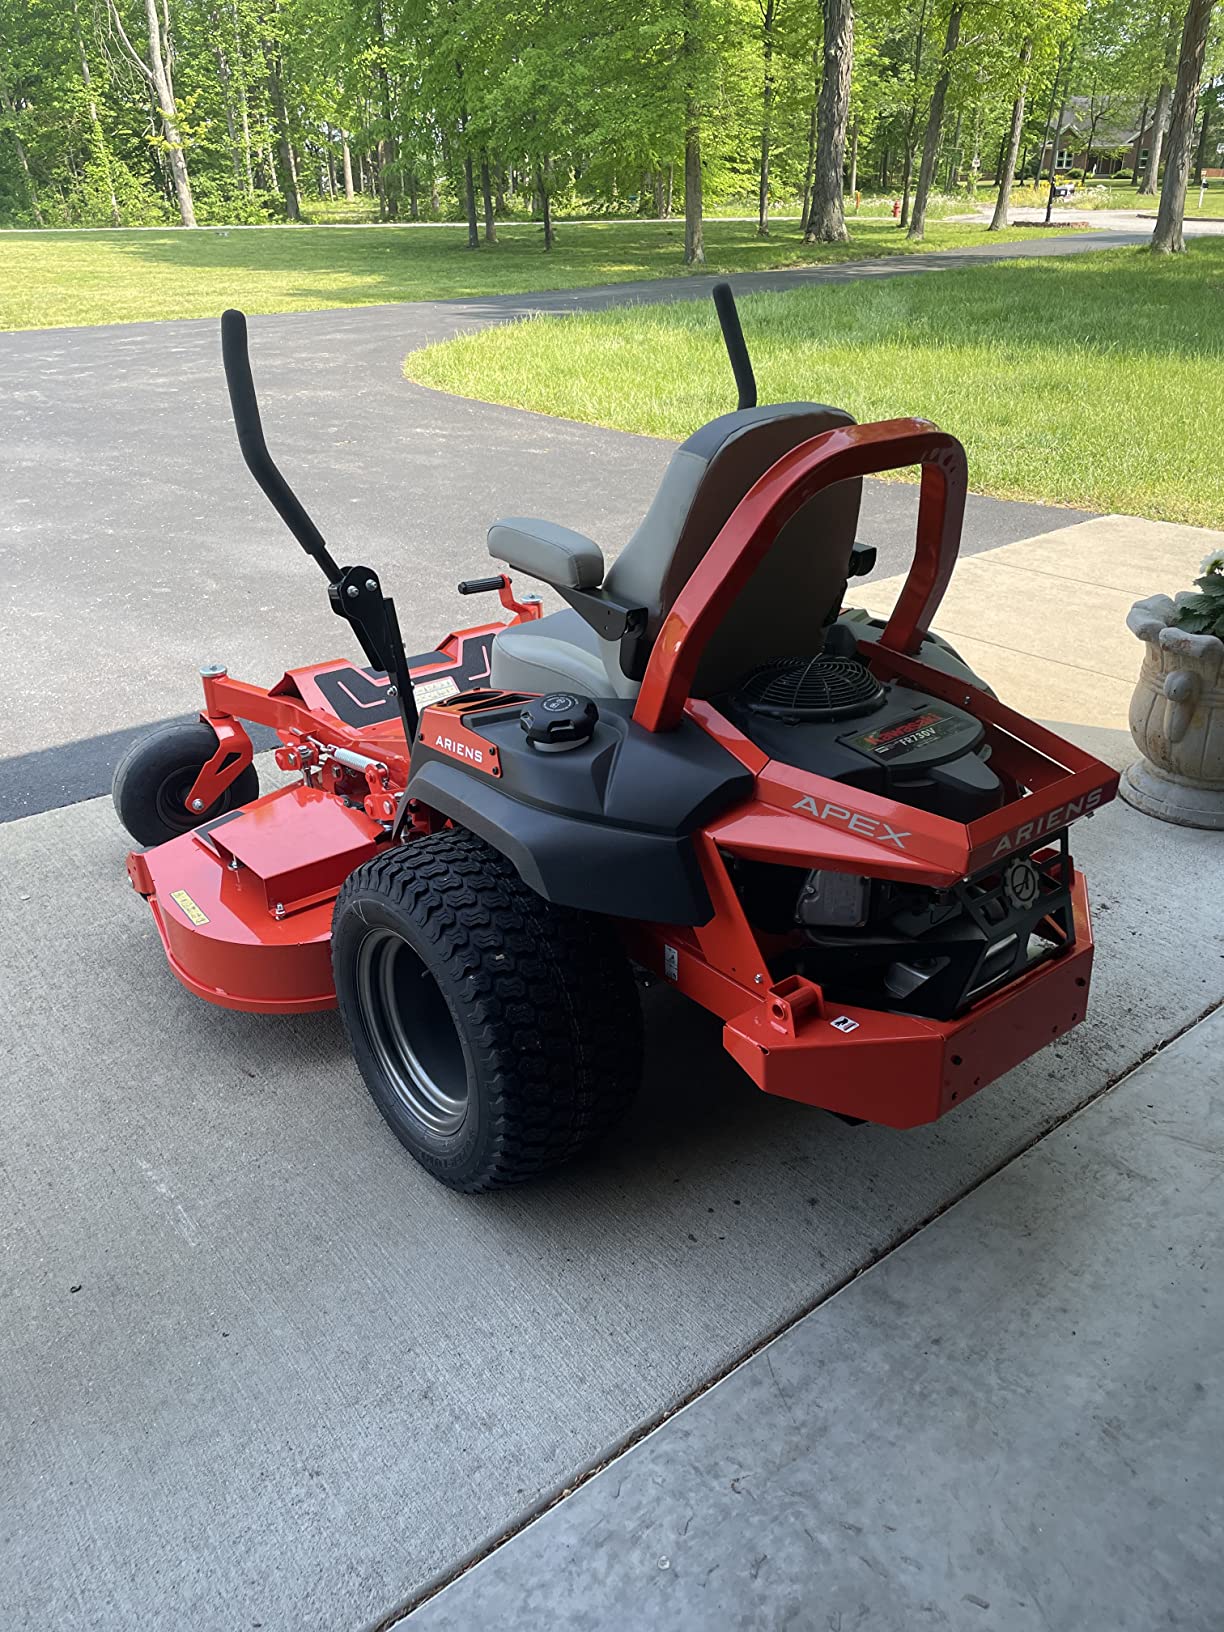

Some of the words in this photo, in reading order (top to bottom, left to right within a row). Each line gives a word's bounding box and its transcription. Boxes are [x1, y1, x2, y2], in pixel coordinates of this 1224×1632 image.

[435, 736, 483, 763] ARIENS
[898, 727, 937, 747] FR730V
[792, 795, 911, 848] APEX
[992, 788, 1103, 858] ARIENS
